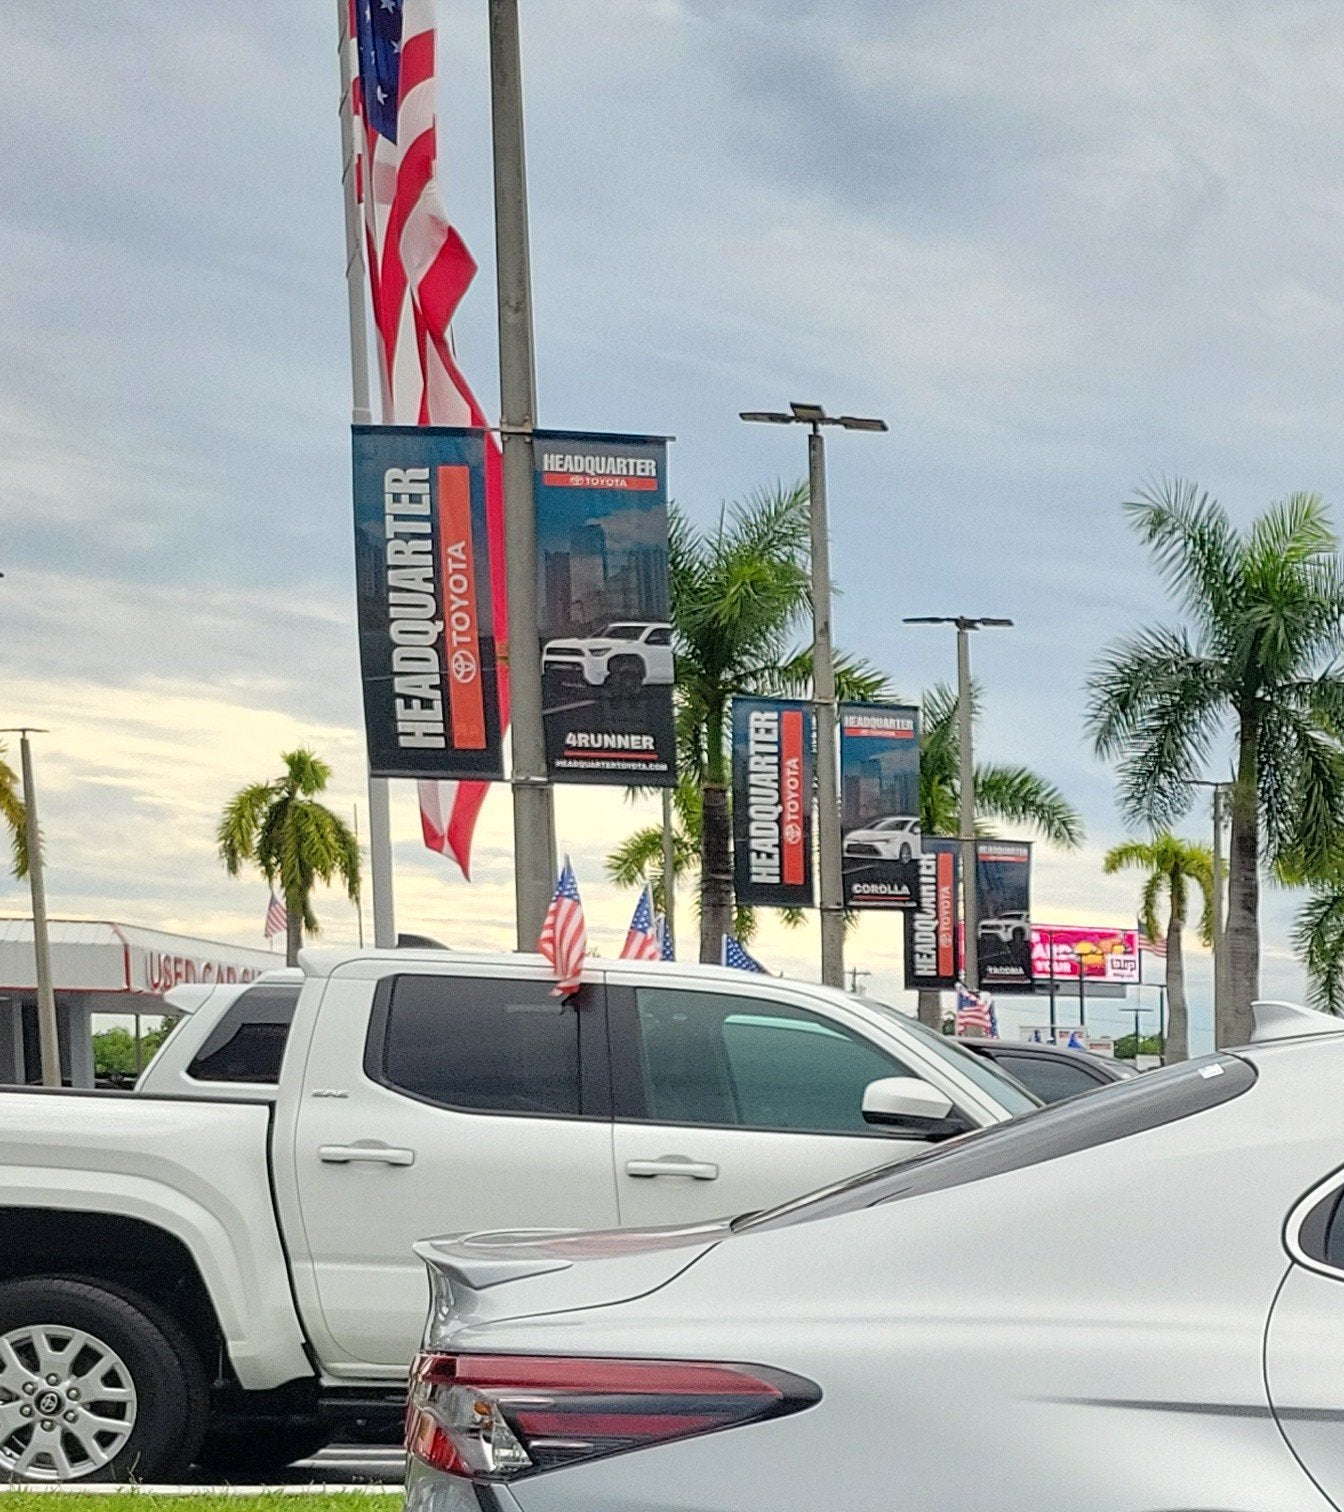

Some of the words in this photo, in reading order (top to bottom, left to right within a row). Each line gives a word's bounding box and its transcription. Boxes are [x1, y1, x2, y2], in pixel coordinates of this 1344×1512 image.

[543, 453, 657, 477] HEADQUARTER
[584, 477, 628, 488] TOYOTA
[384, 467, 446, 749] HEADQUARTER
[447, 540, 473, 647] TOYOTA
[565, 731, 655, 750] 4RUNNER
[748, 711, 783, 884] HEADQUARTER
[783, 757, 799, 821] TOYOTA
[851, 883, 911, 895] COROLLA
[147, 950, 196, 990] USED
